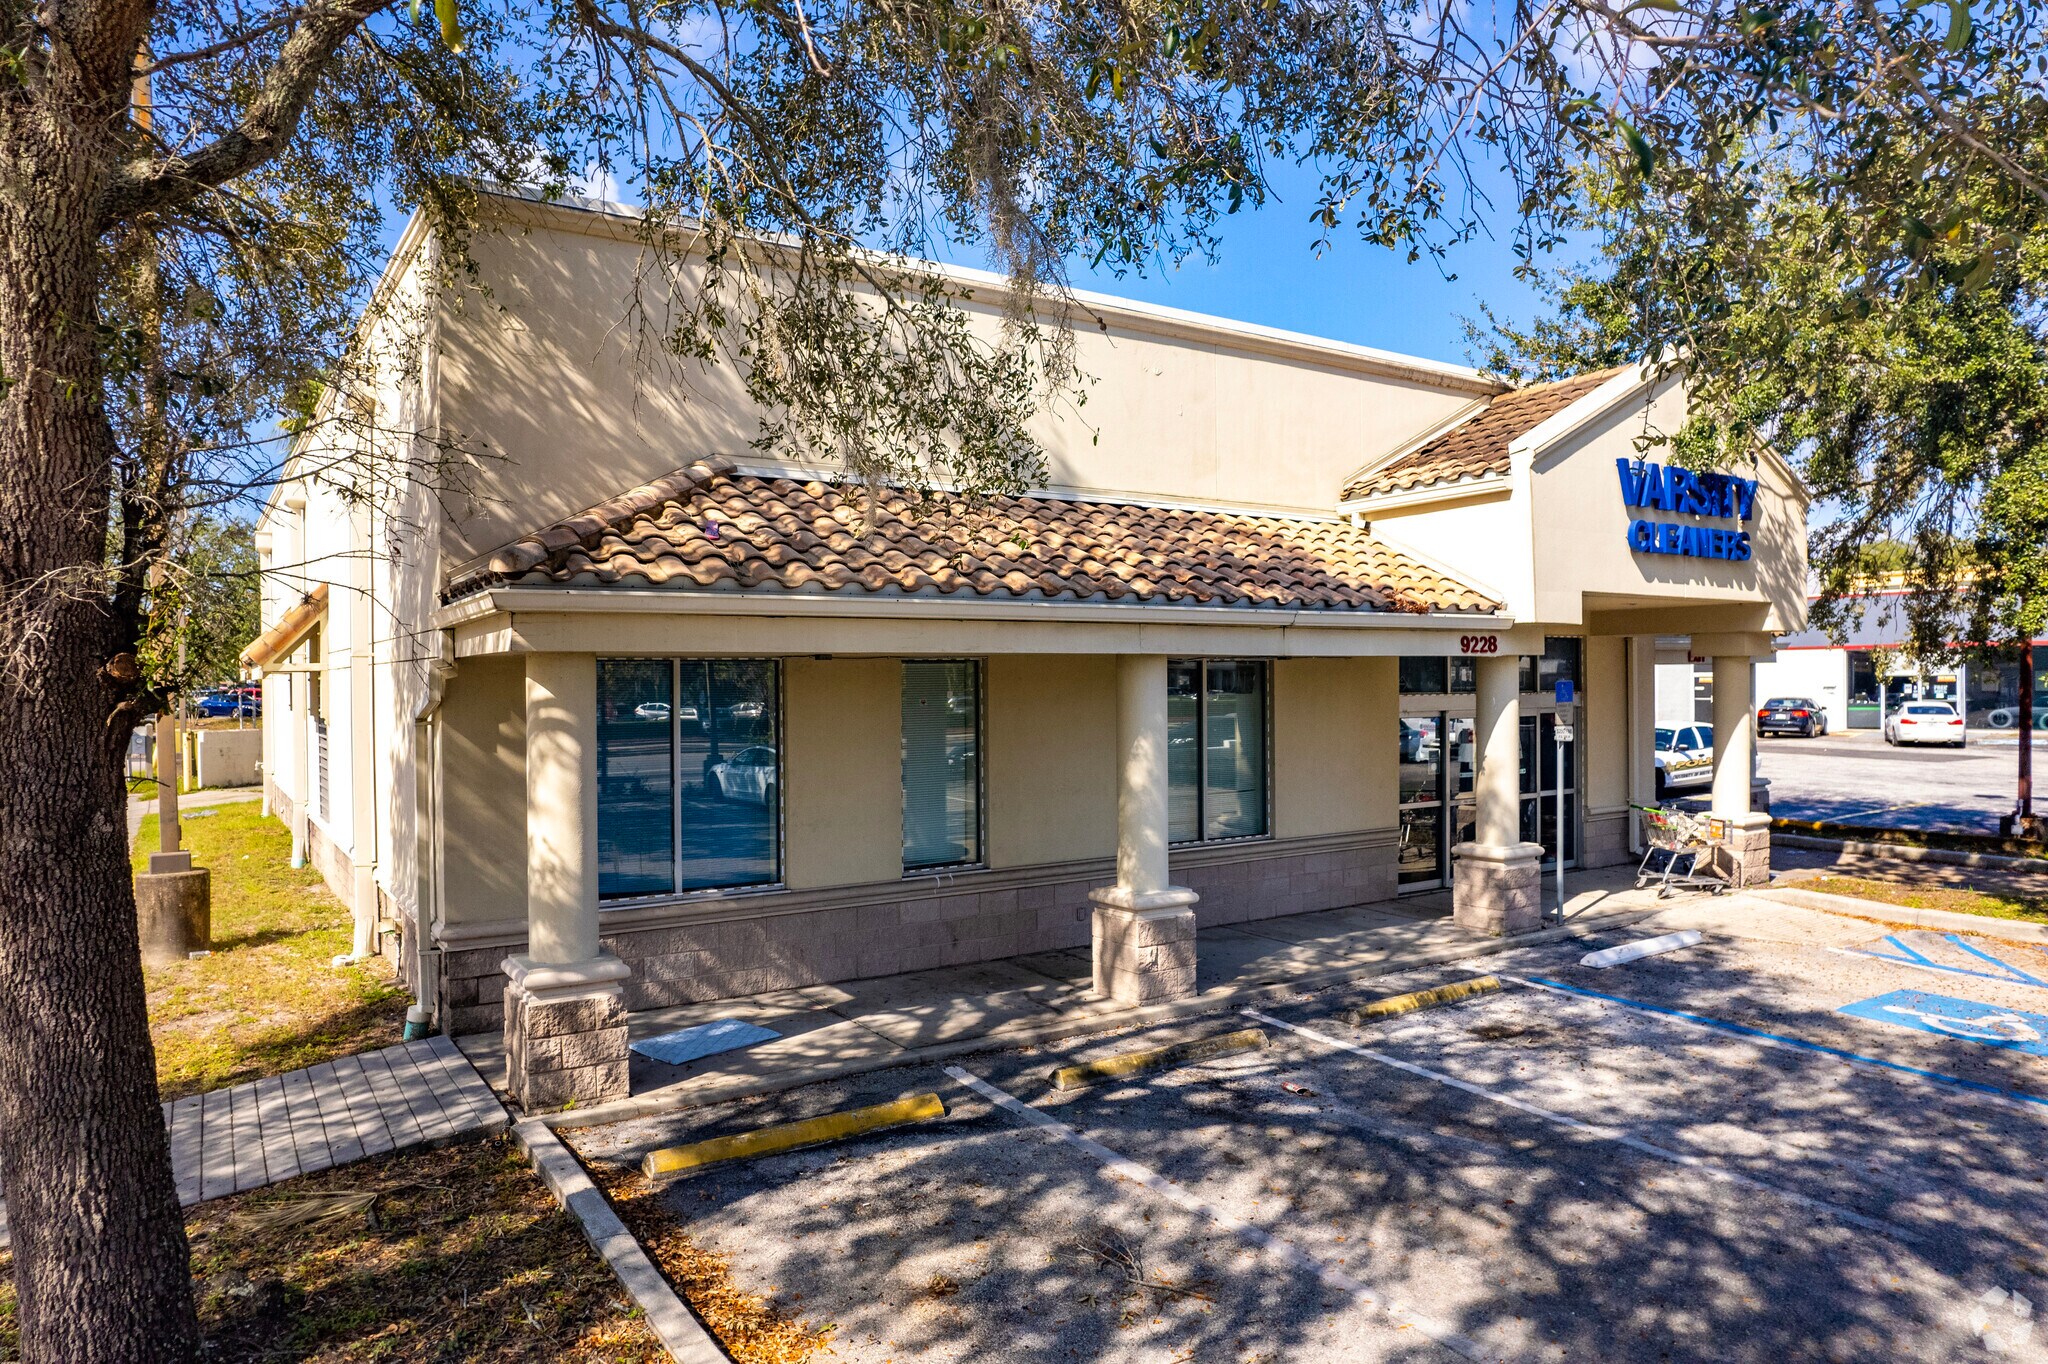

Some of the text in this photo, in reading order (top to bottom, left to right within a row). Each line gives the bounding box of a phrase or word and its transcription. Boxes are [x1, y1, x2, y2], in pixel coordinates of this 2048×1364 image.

[1616, 458, 1758, 520] VARSITY
[1627, 519, 1752, 561] CLEANERS
[1460, 635, 1498, 654] 9228
[1675, 756, 1713, 769] POLI
